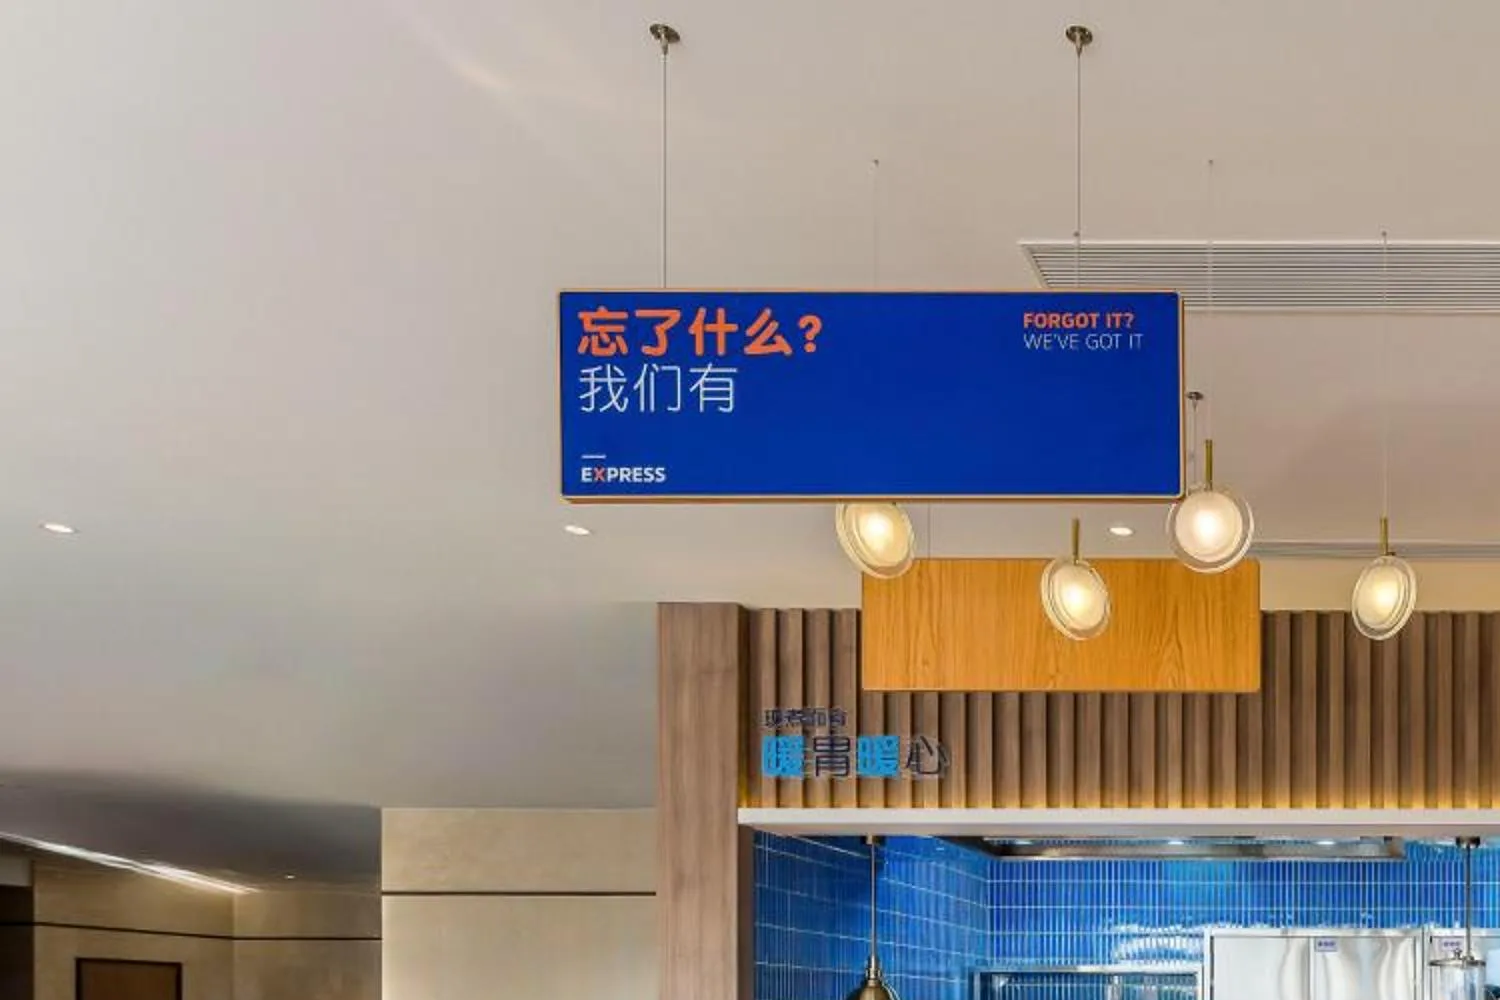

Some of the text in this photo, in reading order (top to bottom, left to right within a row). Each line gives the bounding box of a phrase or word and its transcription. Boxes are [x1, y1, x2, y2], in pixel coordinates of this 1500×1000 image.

[1023, 312, 1135, 329] FORGOT IT?
[1085, 333, 1122, 351] GOT
[1128, 333, 1144, 349] IT
[579, 362, 738, 413] 我们有
[581, 467, 666, 484] EXPRESS
